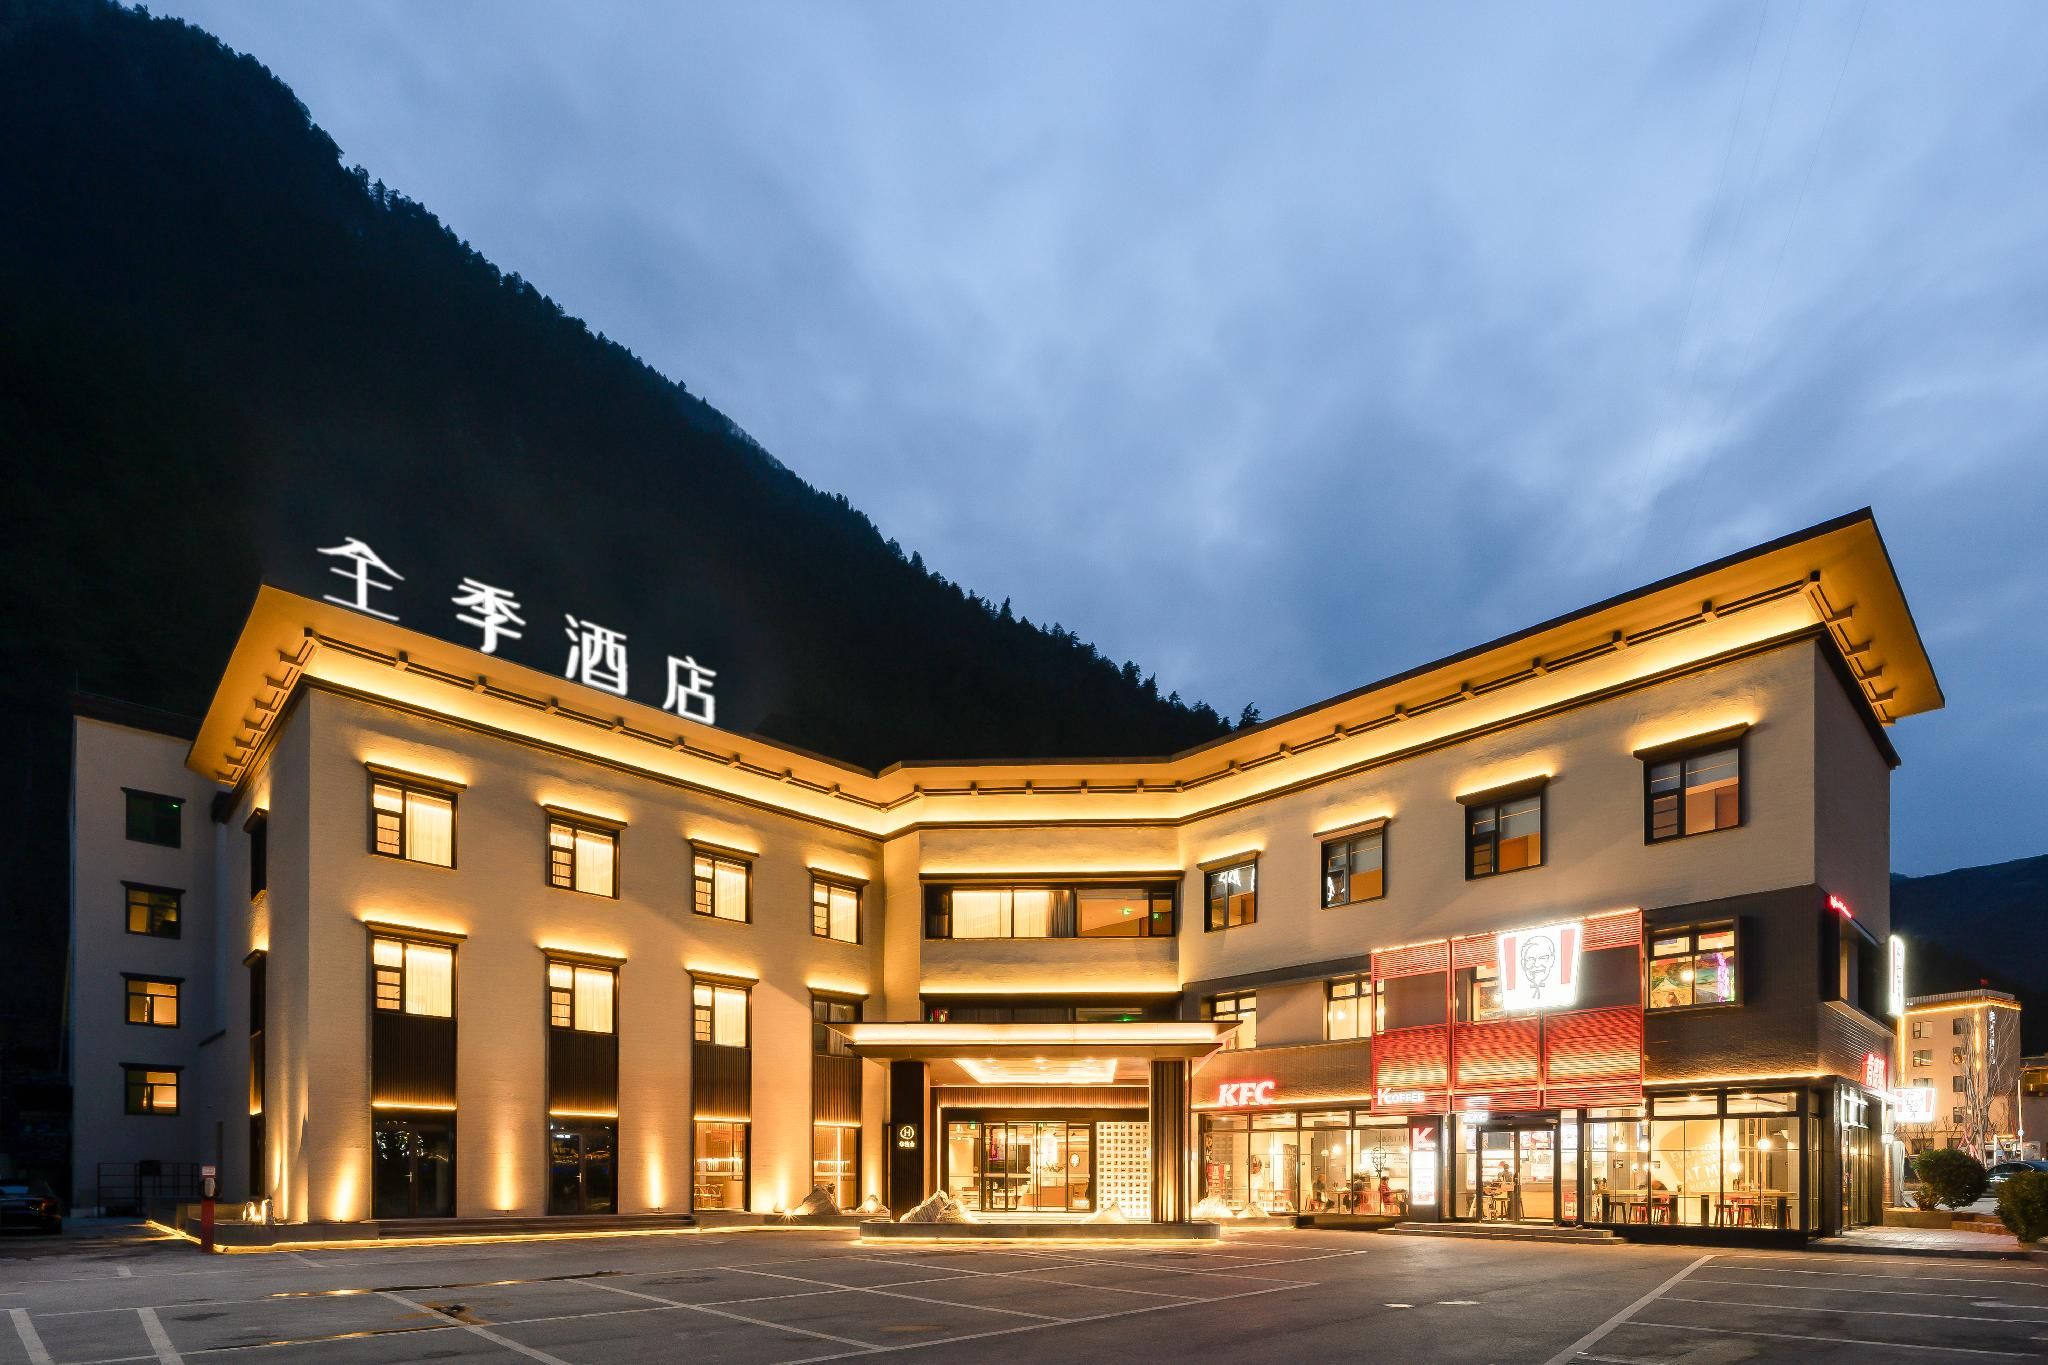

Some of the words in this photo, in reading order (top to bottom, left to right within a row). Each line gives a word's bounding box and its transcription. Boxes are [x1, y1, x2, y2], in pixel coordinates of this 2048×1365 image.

[316, 536, 717, 726] 全季酒店
[1218, 1081, 1275, 1106] KFC
